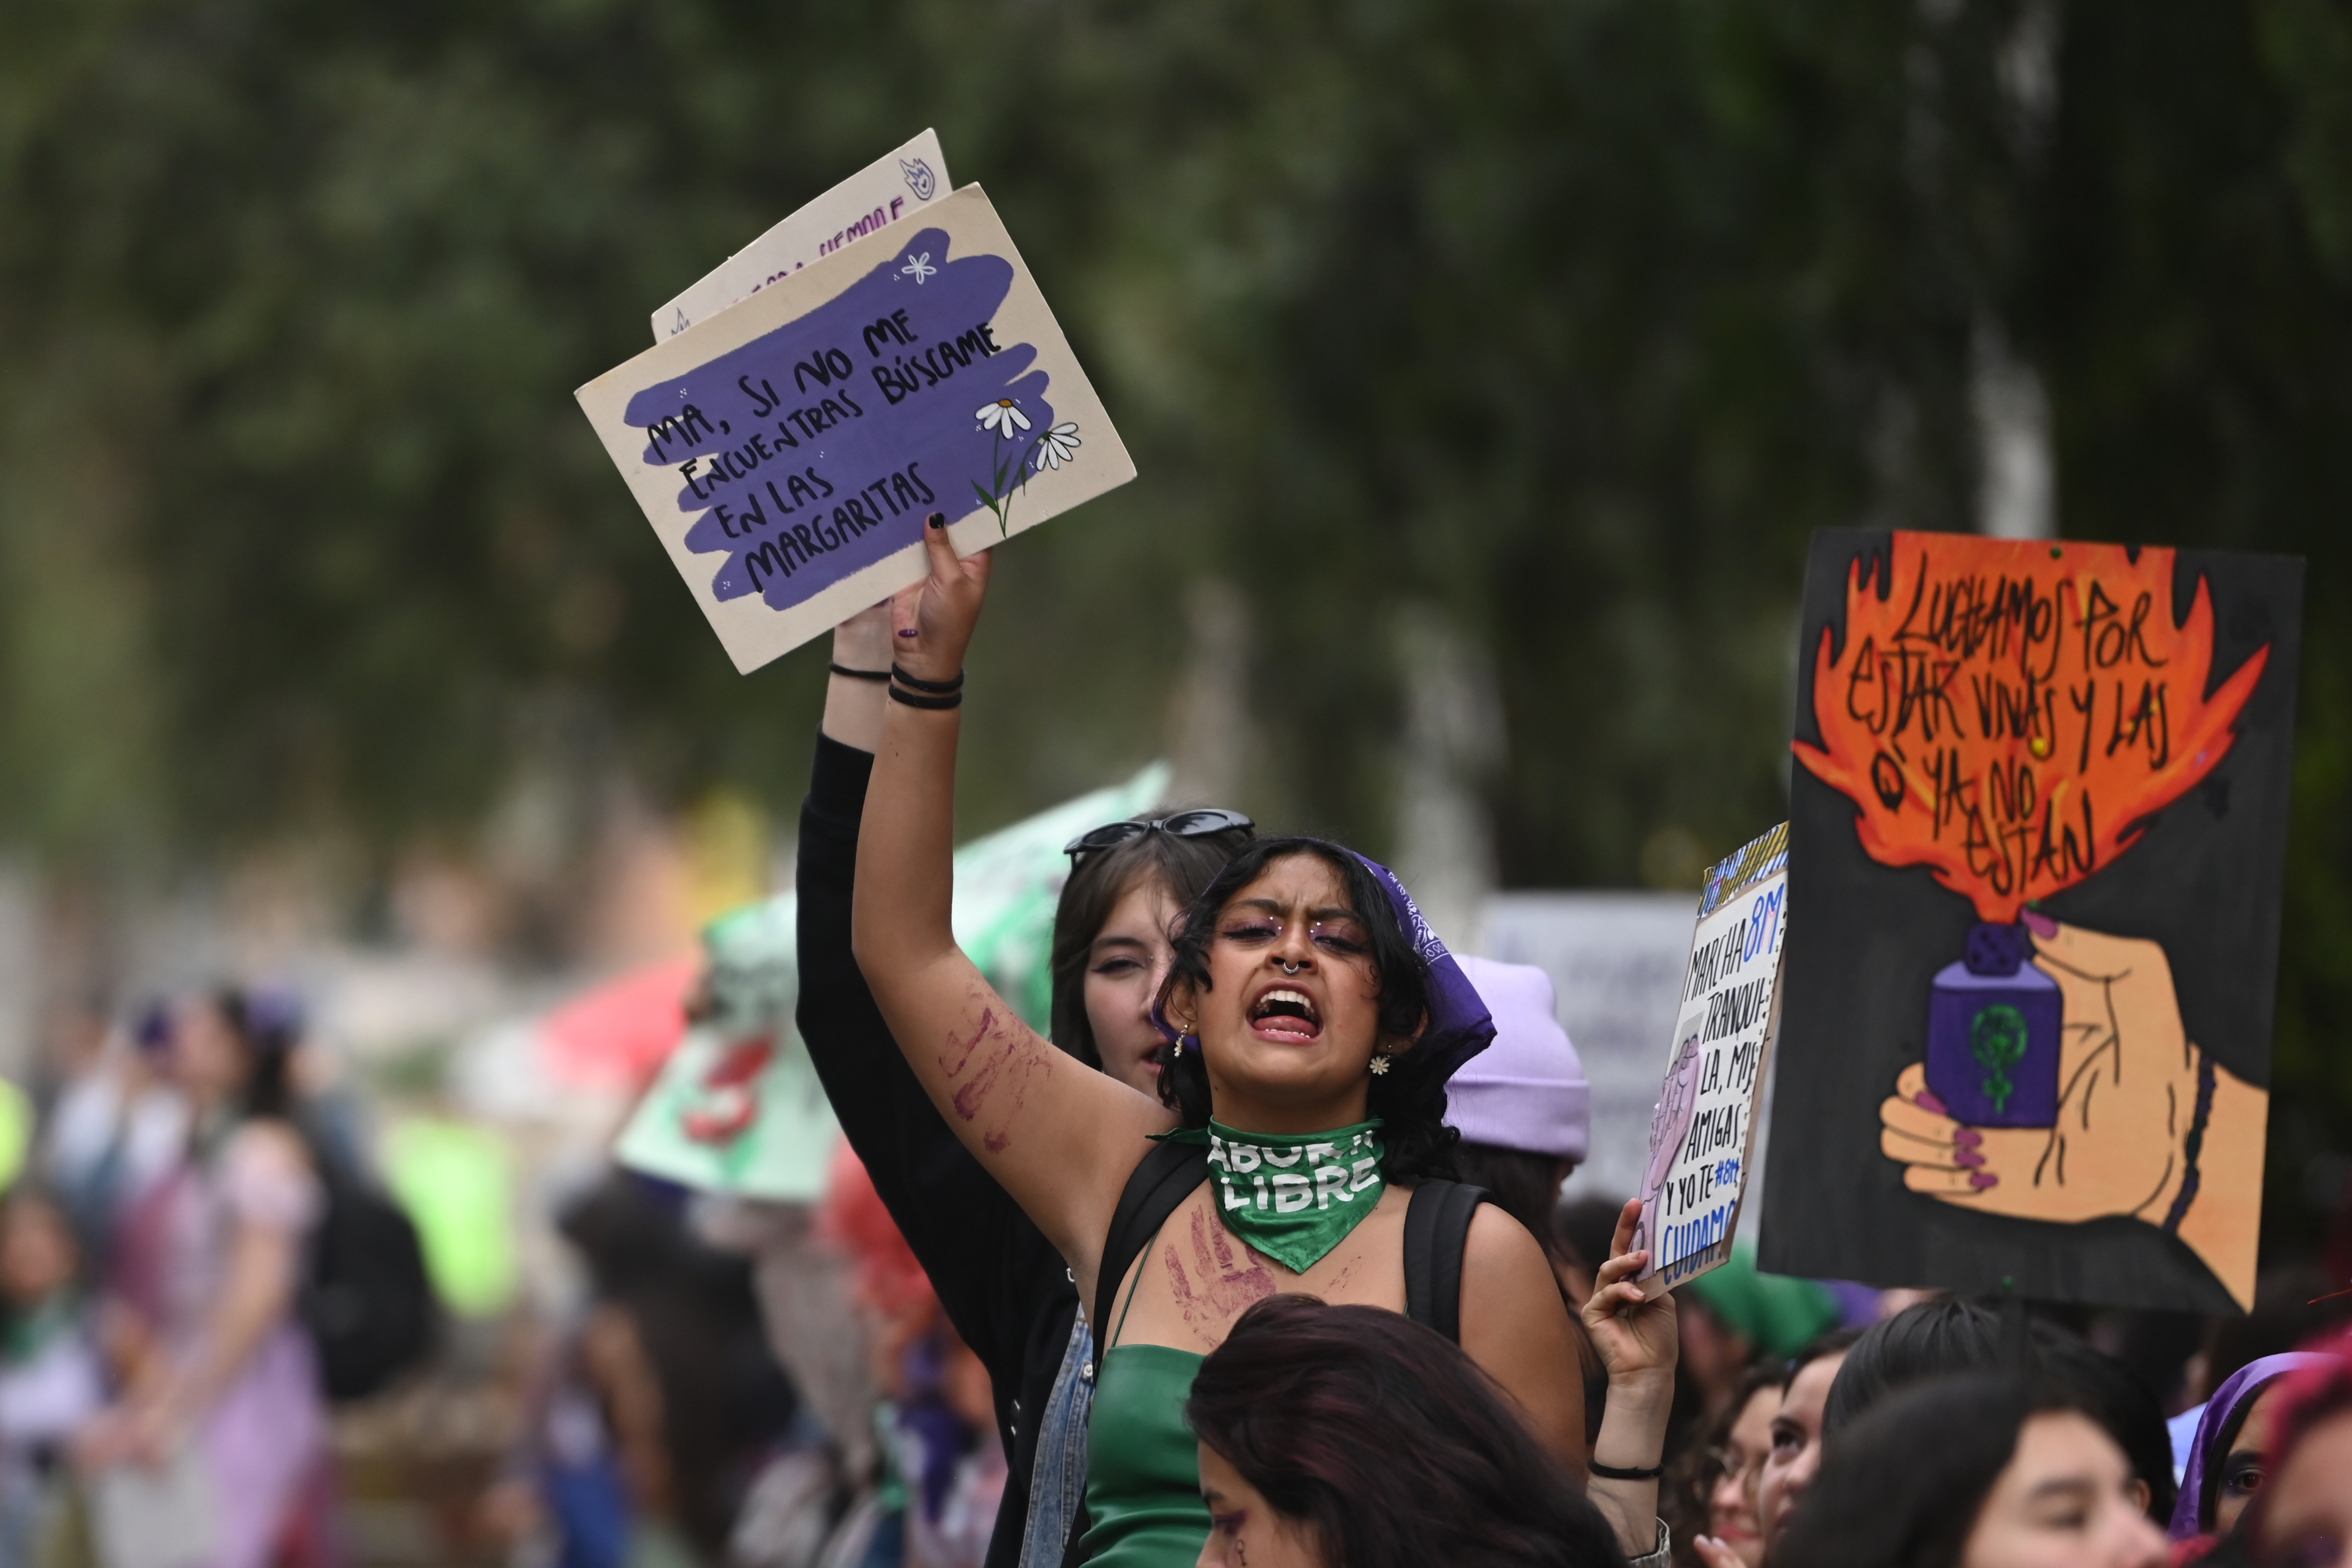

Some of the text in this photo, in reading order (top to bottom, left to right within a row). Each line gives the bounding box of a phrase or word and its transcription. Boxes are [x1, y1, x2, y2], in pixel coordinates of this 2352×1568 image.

[647, 308, 918, 463] MA, SI NO ME
[679, 322, 1001, 500] ENCUENTRAS BÚSCAME
[714, 466, 834, 538] EN LAS
[745, 462, 935, 593] MARGARITAS
[2074, 579, 2169, 673] POR
[2069, 679, 2095, 775] Y
[2105, 678, 2168, 770] LAS
[1922, 747, 1975, 841] YA
[1991, 755, 2036, 822] NO
[1684, 882, 1784, 1003] MARCHA 8M
[1700, 1041, 1757, 1095] LA, MIS
[1683, 1103, 1742, 1164] AMIGAS
[1220, 1157, 1380, 1213] LIBRE
[1666, 1181, 1674, 1216] Y
[1679, 1173, 1695, 1215] YO
[1700, 1164, 1714, 1202] TE
